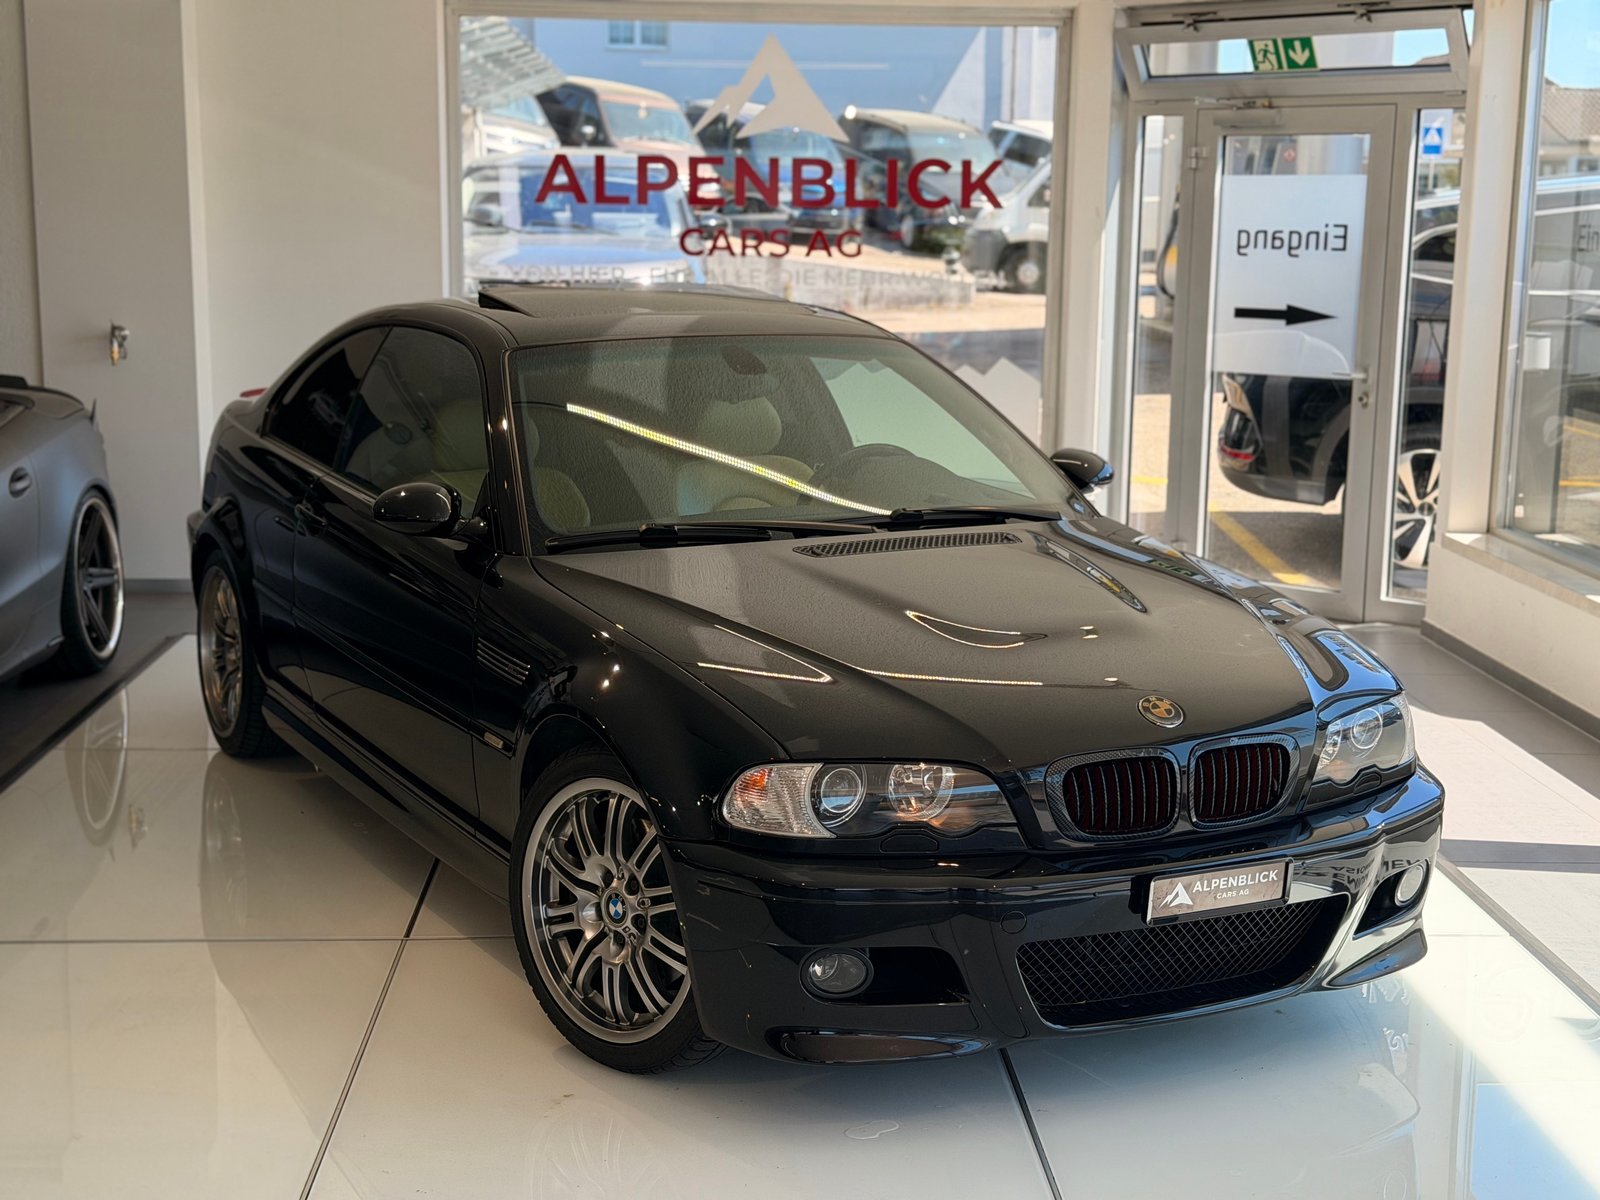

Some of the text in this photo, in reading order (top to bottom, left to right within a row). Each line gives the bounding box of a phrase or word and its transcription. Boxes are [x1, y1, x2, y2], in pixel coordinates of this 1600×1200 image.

[535, 153, 1004, 209] ALPENBLICK
[679, 228, 863, 258] CARS AG
[1192, 869, 1279, 893] ALPENBLICK
[1216, 890, 1237, 899] CARS
